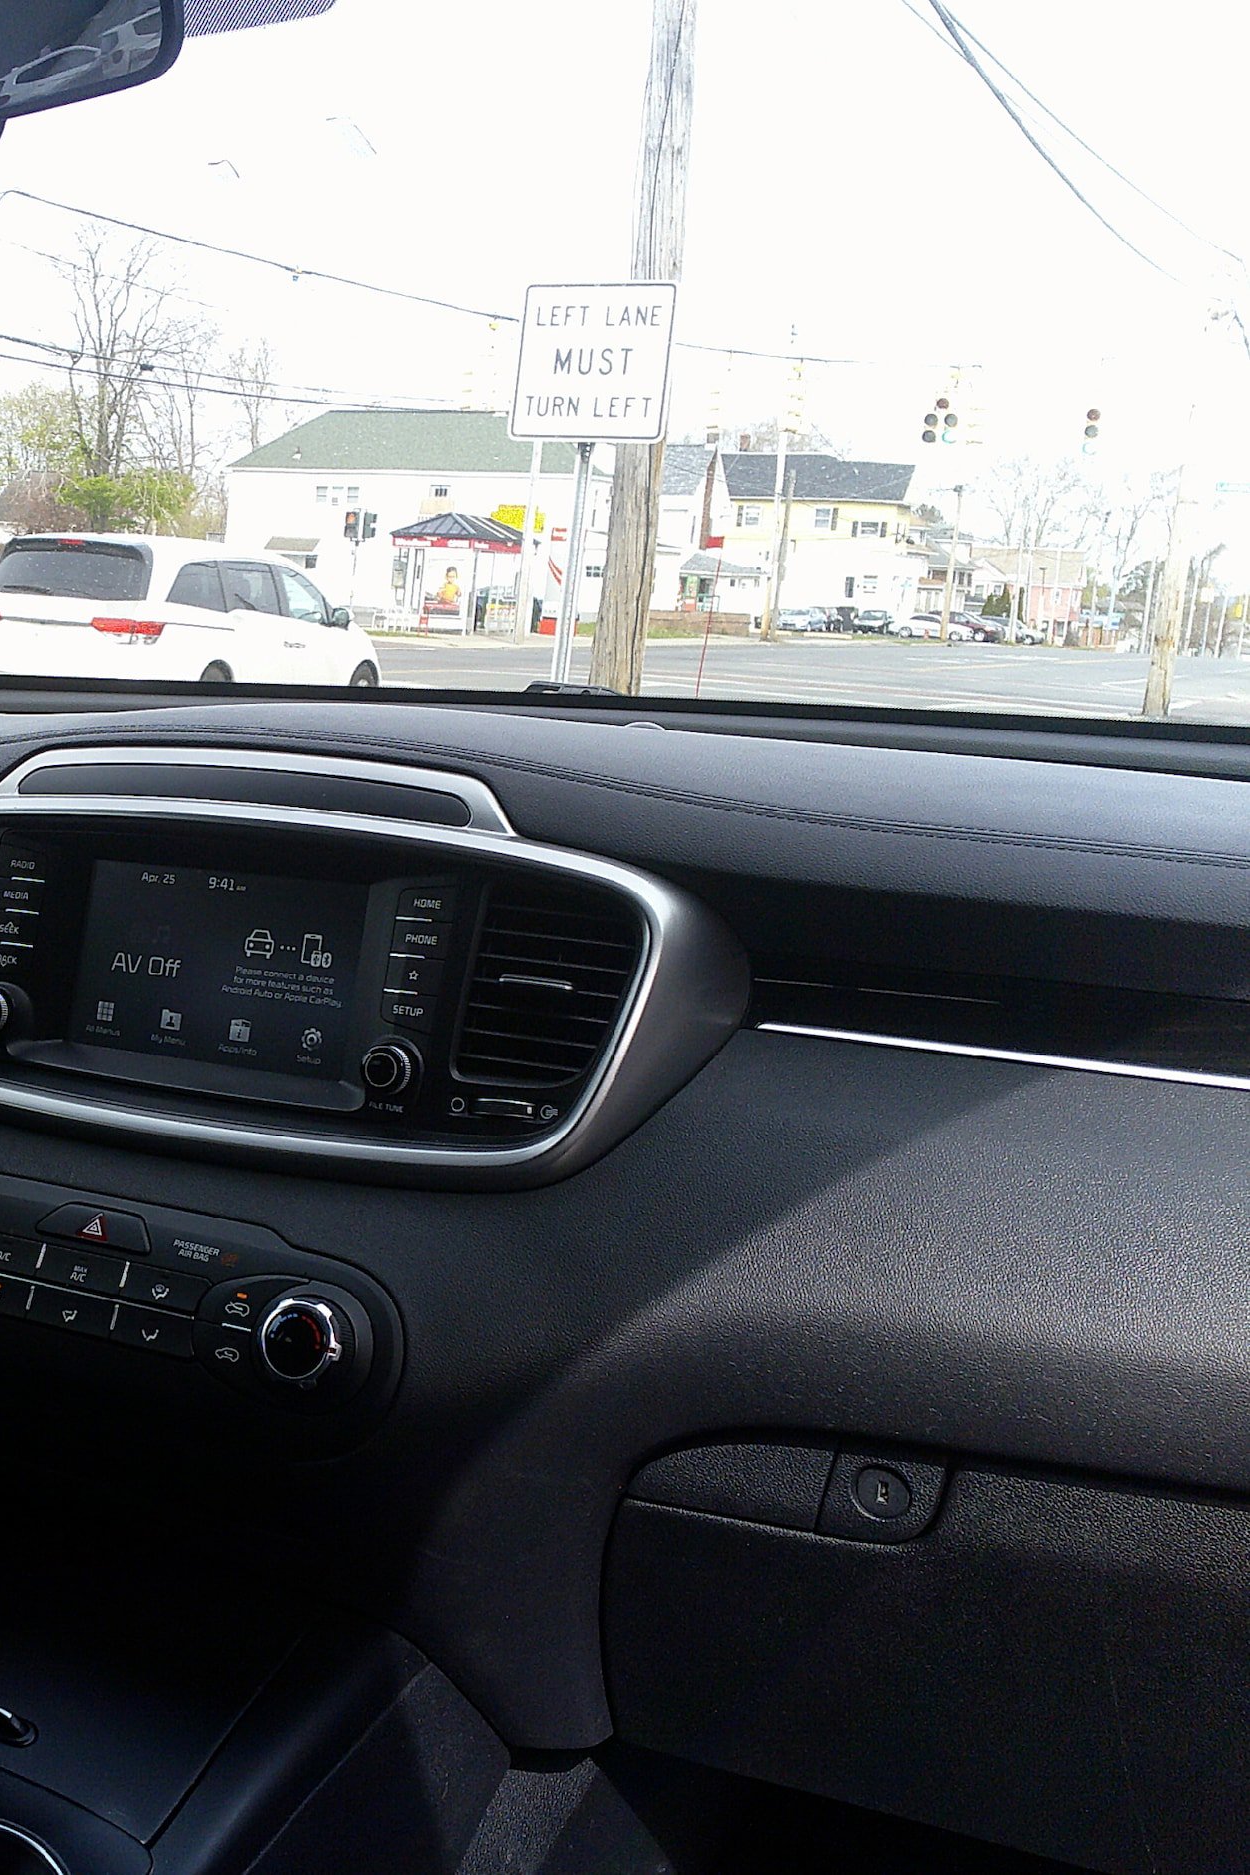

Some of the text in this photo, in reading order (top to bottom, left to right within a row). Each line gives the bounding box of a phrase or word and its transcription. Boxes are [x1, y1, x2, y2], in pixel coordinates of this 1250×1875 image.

[535, 303, 663, 328] LEFT LANE
[552, 346, 634, 376] MUST
[525, 394, 653, 419] TURN LEFT
[9, 858, 36, 871] RADIO
[162, 872, 177, 885] 25
[208, 876, 236, 892] 9:41
[2, 889, 30, 901] MEDIA
[413, 898, 443, 910] HOME
[405, 933, 439, 946] PHONE
[110, 951, 183, 979] AV Off
[234, 965, 263, 977] Please
[263, 969, 297, 981] connect
[305, 973, 336, 985] device
[232, 975, 335, 996] for more features such as
[221, 984, 253, 997] Android
[253, 988, 274, 1000] Auto
[274, 991, 284, 1000] or
[283, 991, 309, 1005] Apple
[392, 1004, 425, 1018] SETUP
[295, 1053, 323, 1066] Setup
[172, 1238, 220, 1257] PASSENGER
[177, 1248, 194, 1260] AIR
[193, 1251, 211, 1264] BAG
[69, 1273, 87, 1284] A/C
